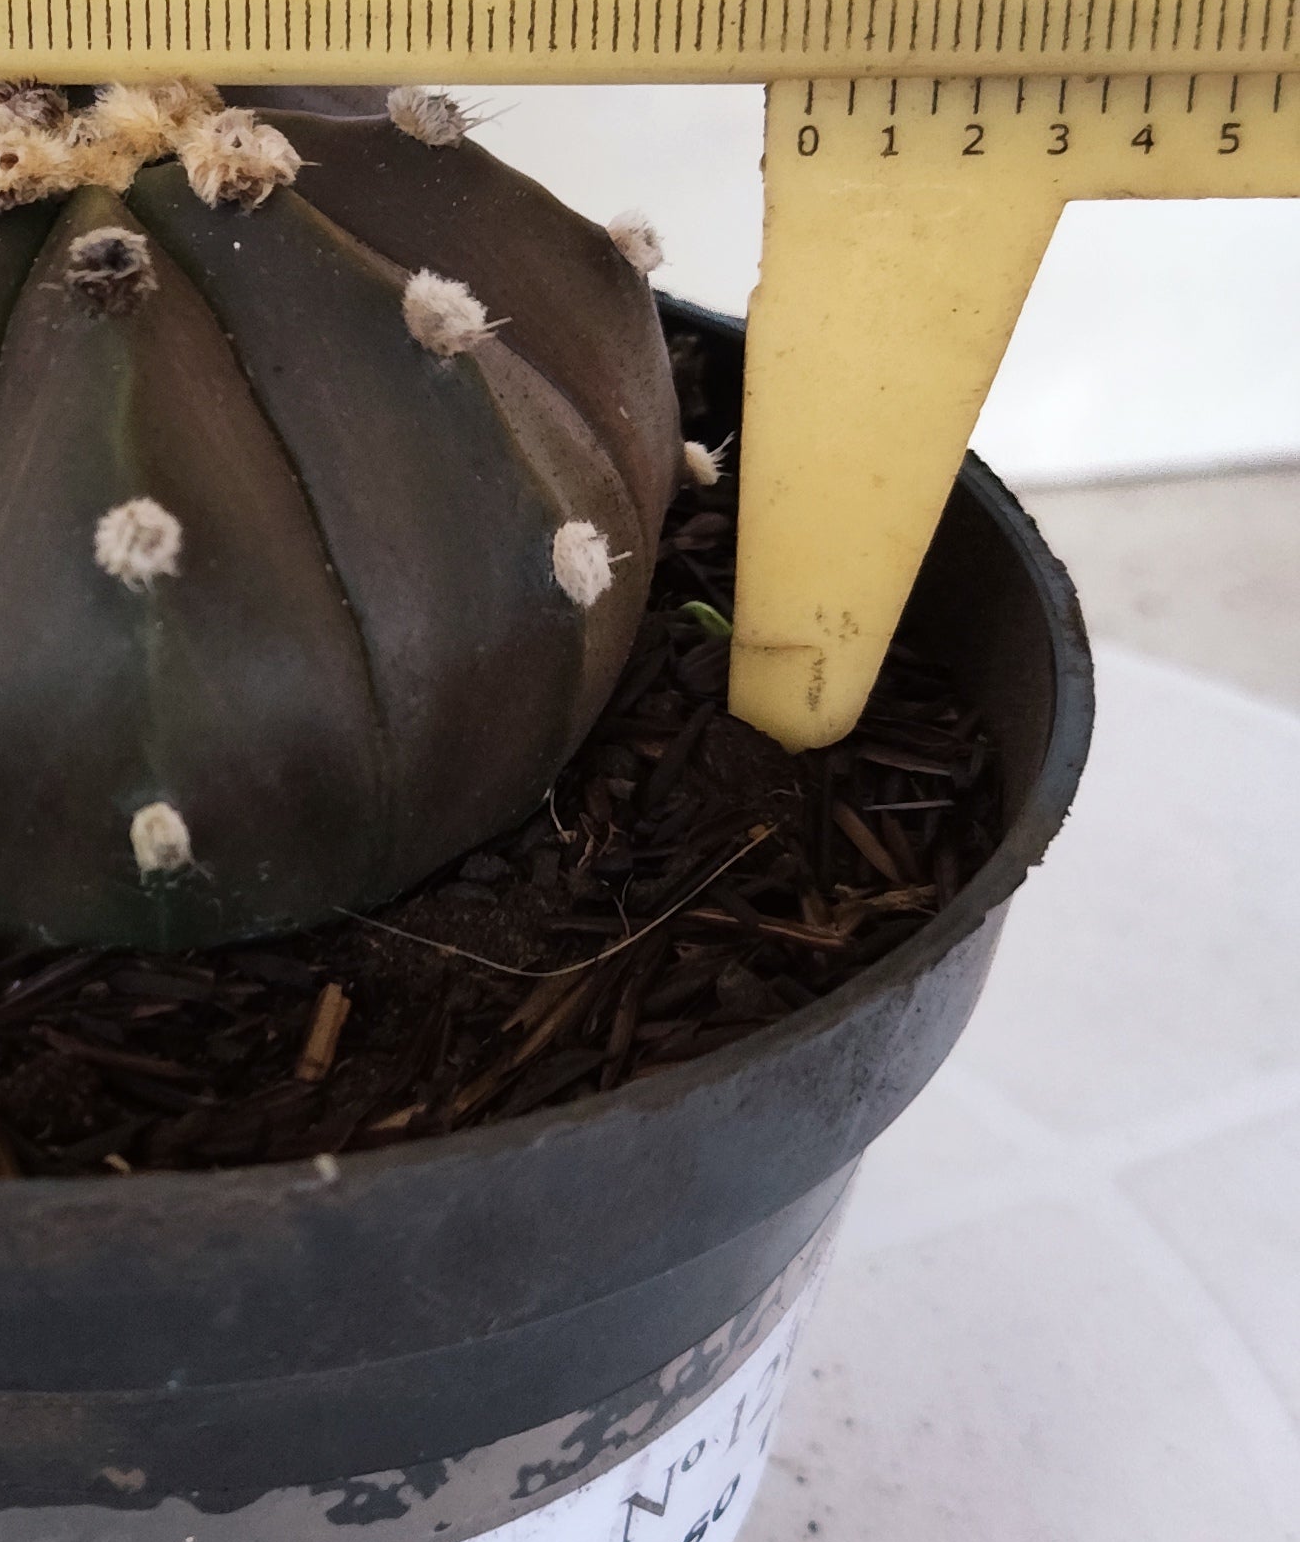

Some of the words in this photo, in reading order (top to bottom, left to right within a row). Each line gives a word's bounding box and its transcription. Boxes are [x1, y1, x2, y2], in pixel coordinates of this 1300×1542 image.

[797, 124, 820, 157] 0
[880, 124, 899, 158] 1
[961, 123, 985, 156] 2
[1046, 124, 1070, 156] 3
[1130, 124, 1155, 155] 4
[1217, 122, 1242, 155] 5
